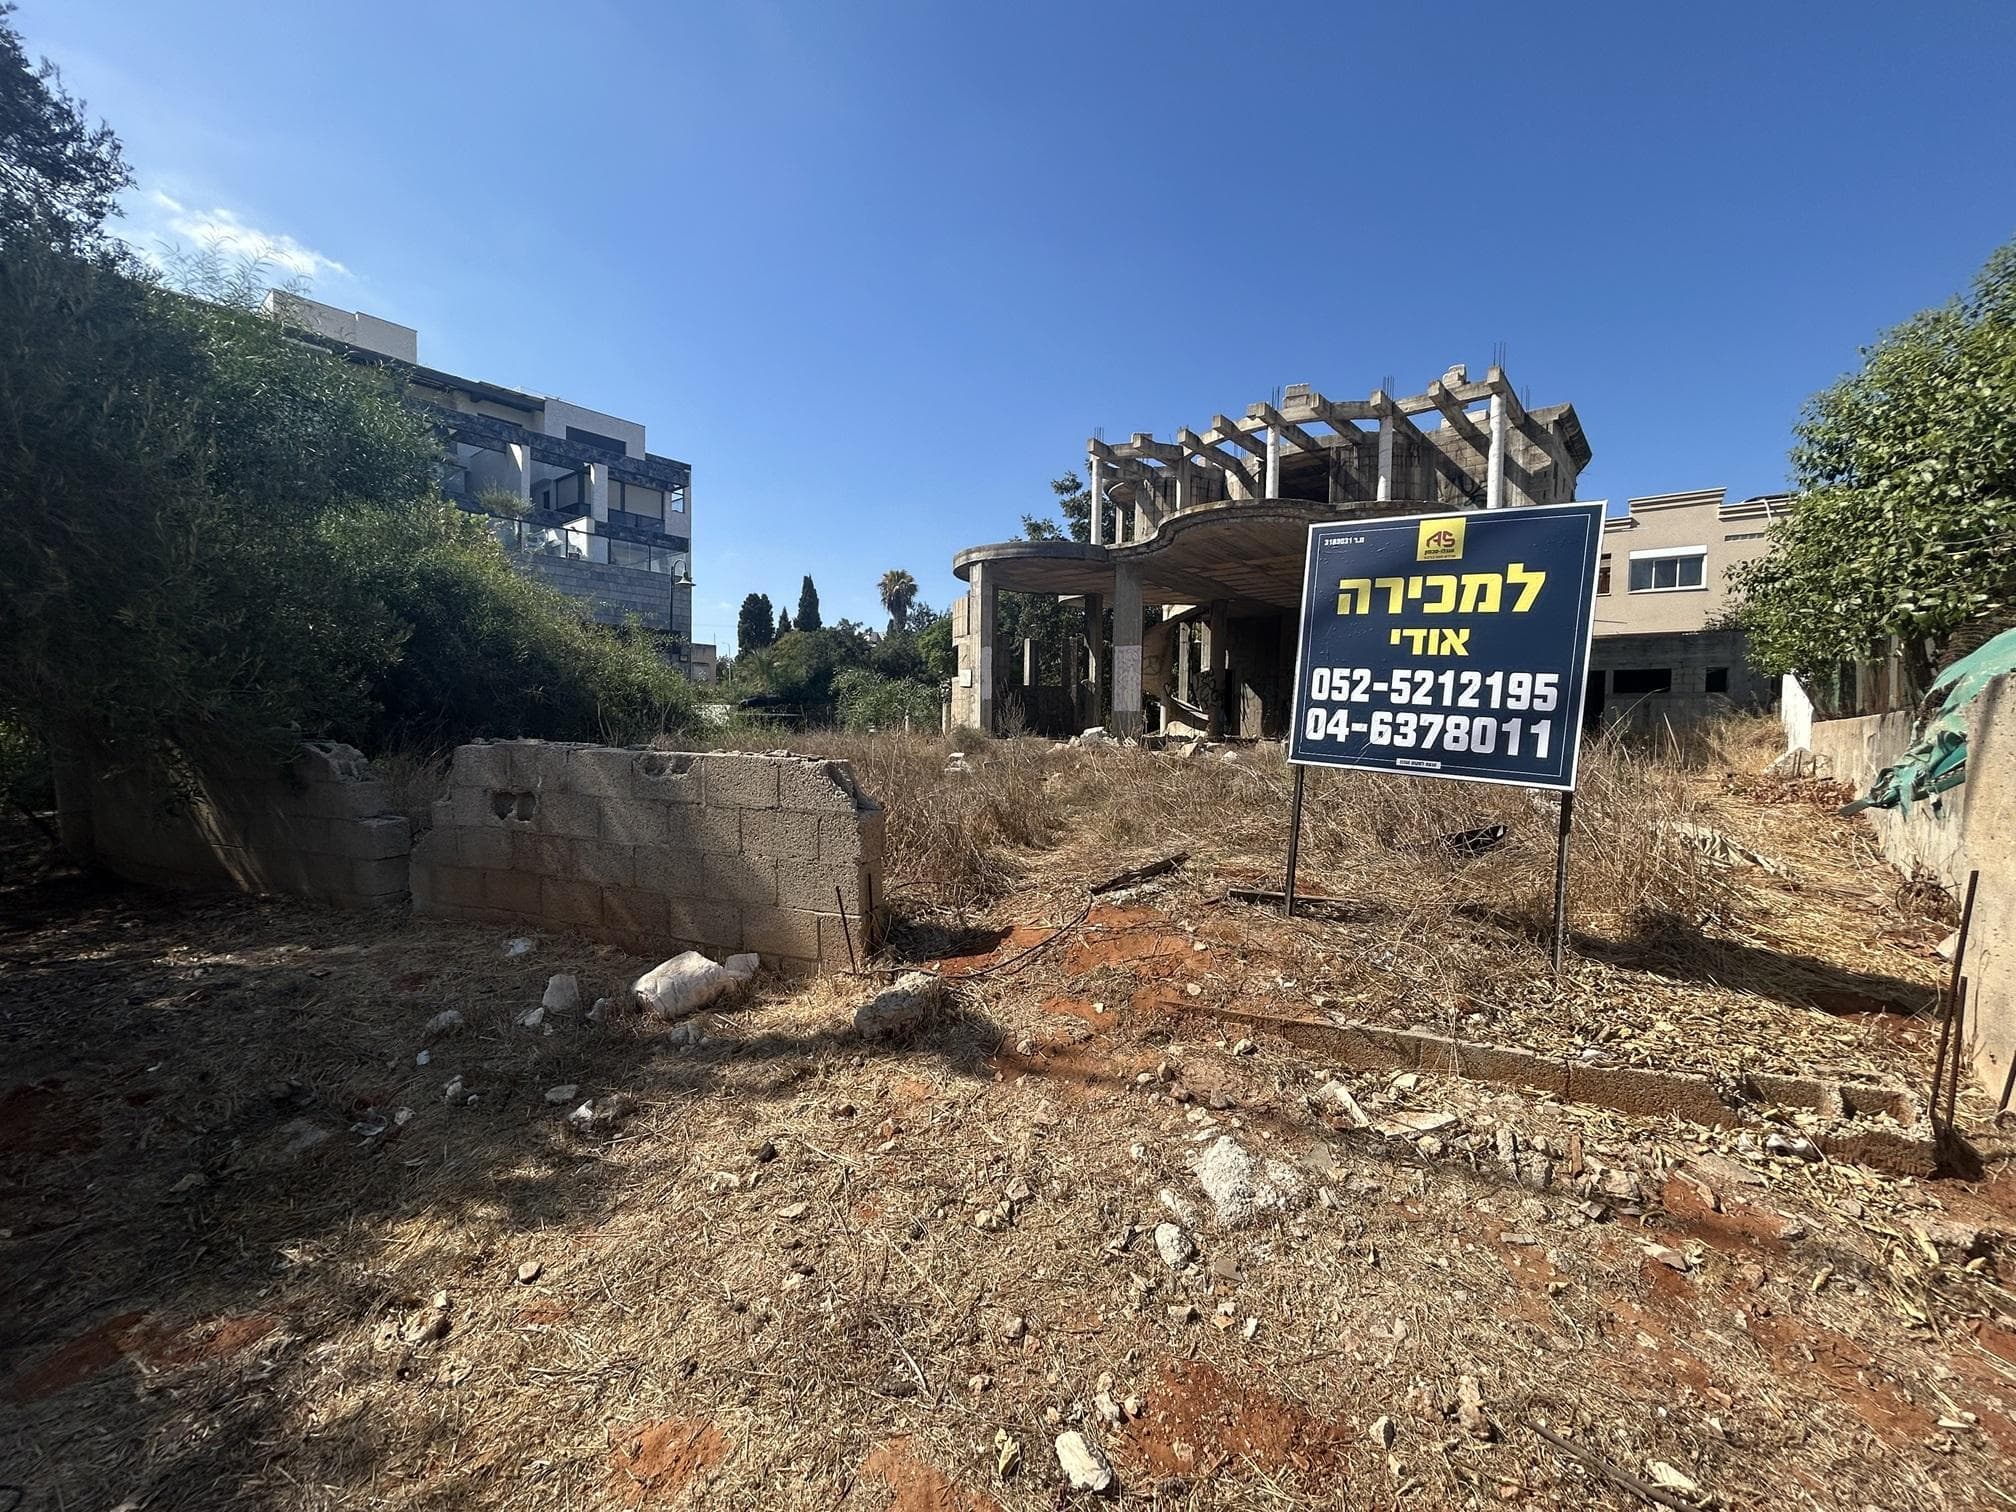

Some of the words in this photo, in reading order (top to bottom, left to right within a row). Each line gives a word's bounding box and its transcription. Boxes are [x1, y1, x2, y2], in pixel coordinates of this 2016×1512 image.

[1336, 562, 1547, 615] למכירה
[1389, 628, 1471, 656] אודי
[1310, 667, 1560, 712] 052-5212195
[1305, 707, 1552, 759] 04-6378011
